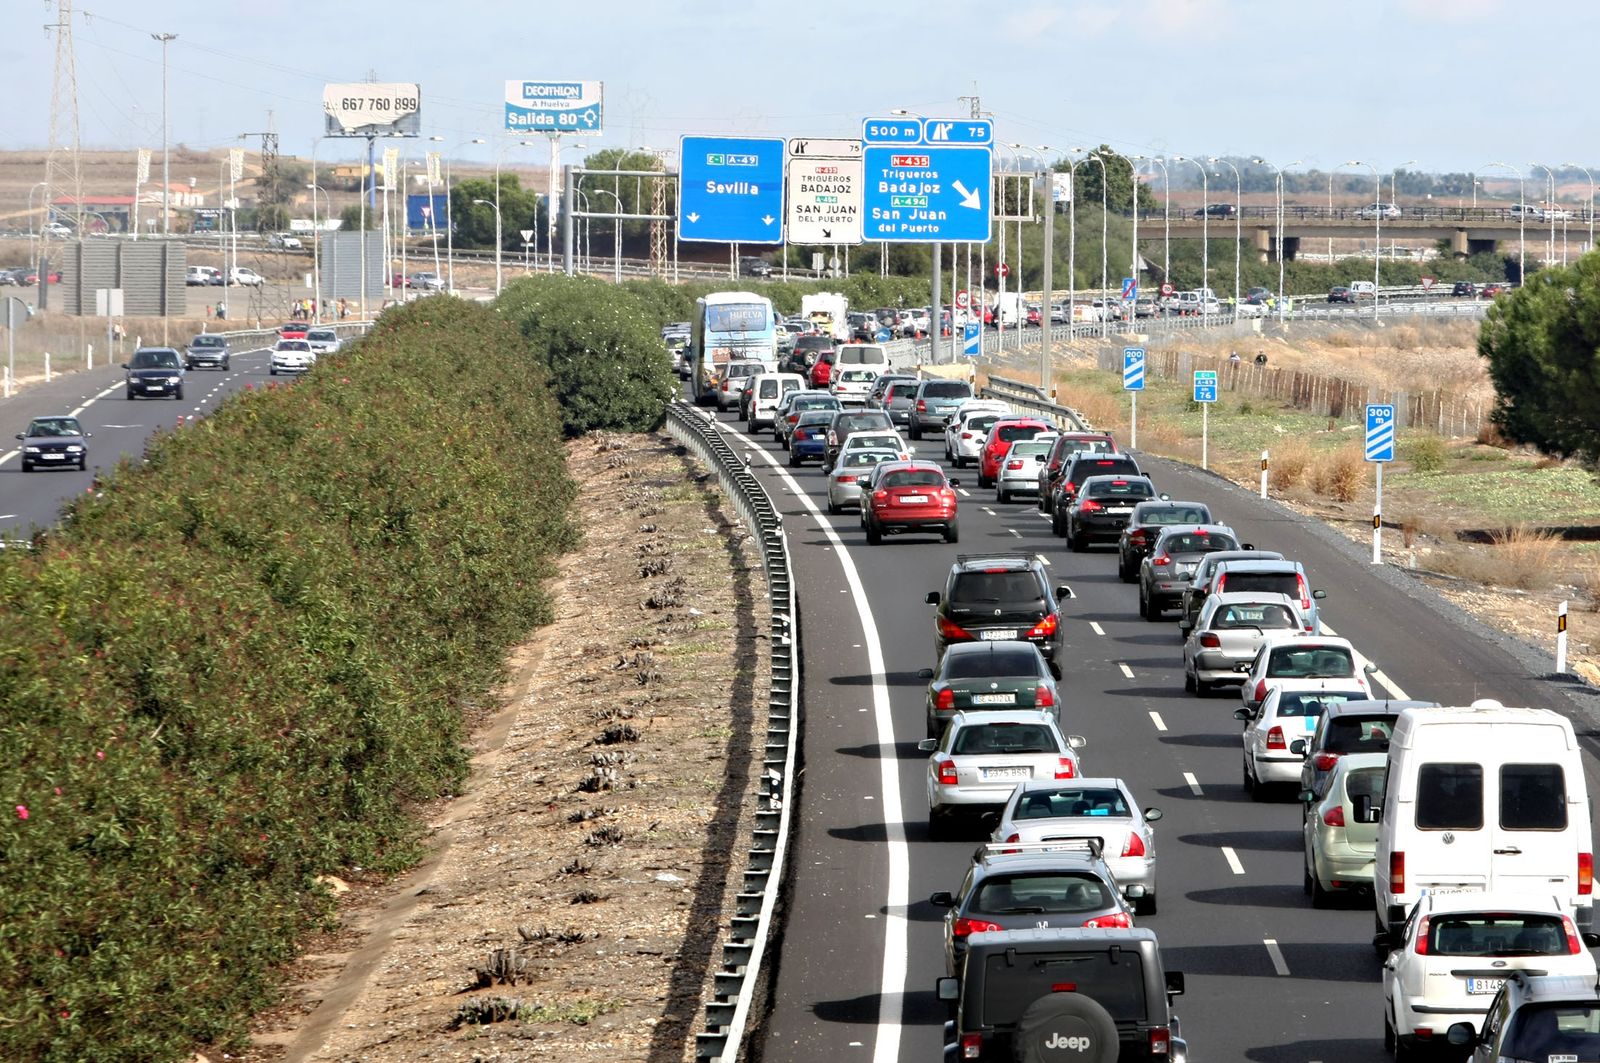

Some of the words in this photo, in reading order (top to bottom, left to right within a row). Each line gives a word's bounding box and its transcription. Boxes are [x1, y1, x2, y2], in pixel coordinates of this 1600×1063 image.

[342, 98, 364, 110] 667
[368, 98, 390, 110] 760
[394, 98, 416, 110] 899
[508, 112, 554, 124] Salida
[559, 112, 577, 124] 80
[870, 126, 898, 137] 500
[904, 129, 914, 137] m
[968, 128, 984, 137] 75
[708, 155, 724, 164] E-1
[728, 155, 757, 166] A-49
[892, 156, 928, 166] N-435
[882, 169, 938, 180] Trigueros
[706, 181, 759, 195] Sevilla
[800, 184, 852, 194] BADAJOZ
[879, 181, 941, 196] Badajoz
[893, 196, 927, 206] A-494
[796, 205, 822, 214] SAN
[826, 205, 857, 214] JUAN
[872, 208, 900, 219] San
[908, 208, 946, 220] Juan
[878, 223, 896, 232] del
[902, 223, 940, 233] Puerto
[730, 311, 763, 319] HUELVA
[1369, 408, 1390, 416] 300
[988, 769, 1008, 777] 5375
[1476, 980, 1502, 990] 8148
[1045, 1032, 1090, 1052] Jeep
